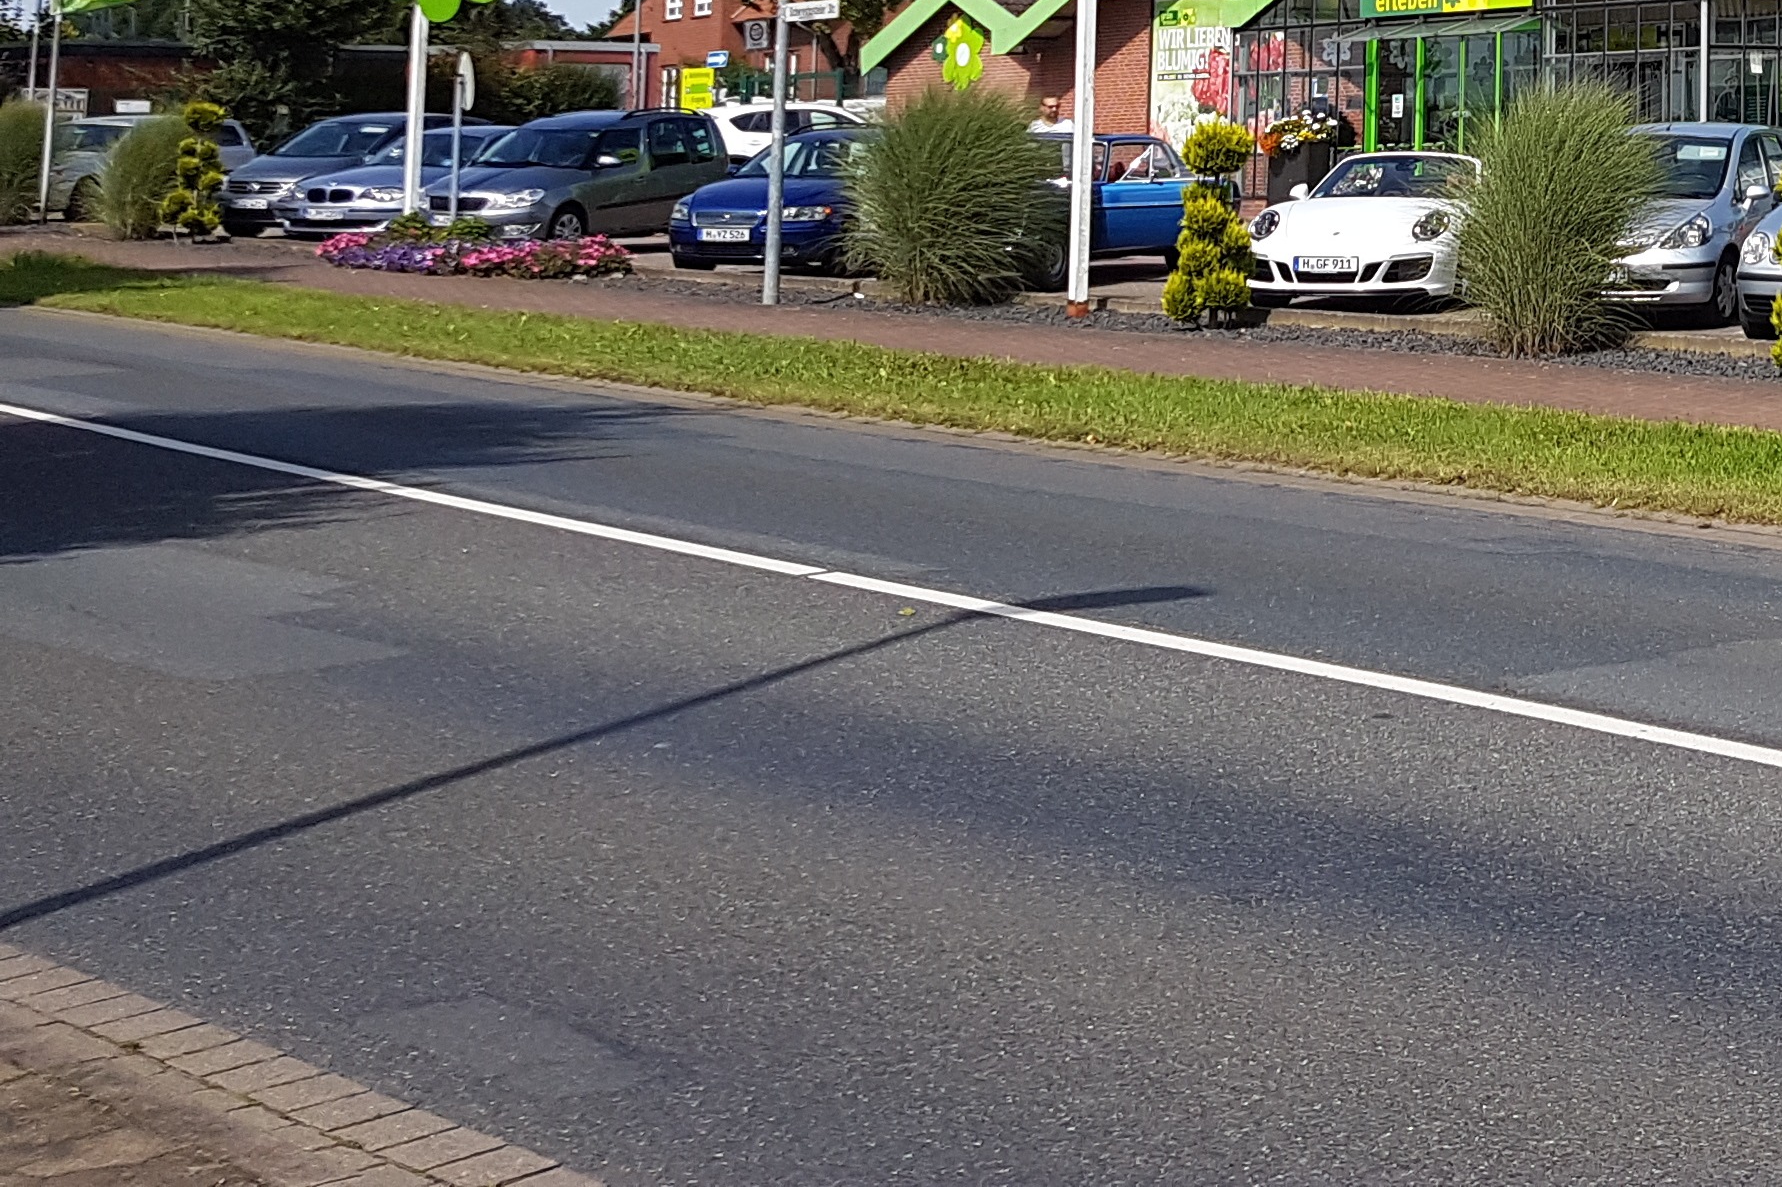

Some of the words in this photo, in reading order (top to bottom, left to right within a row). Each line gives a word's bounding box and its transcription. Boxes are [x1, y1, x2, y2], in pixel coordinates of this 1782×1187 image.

[1158, 28, 1185, 50] WIR
[1157, 48, 1210, 71] BLUMIG!
[1302, 258, 1310, 269] H
[1316, 258, 1330, 270] GF
[1332, 258, 1352, 270] 911
